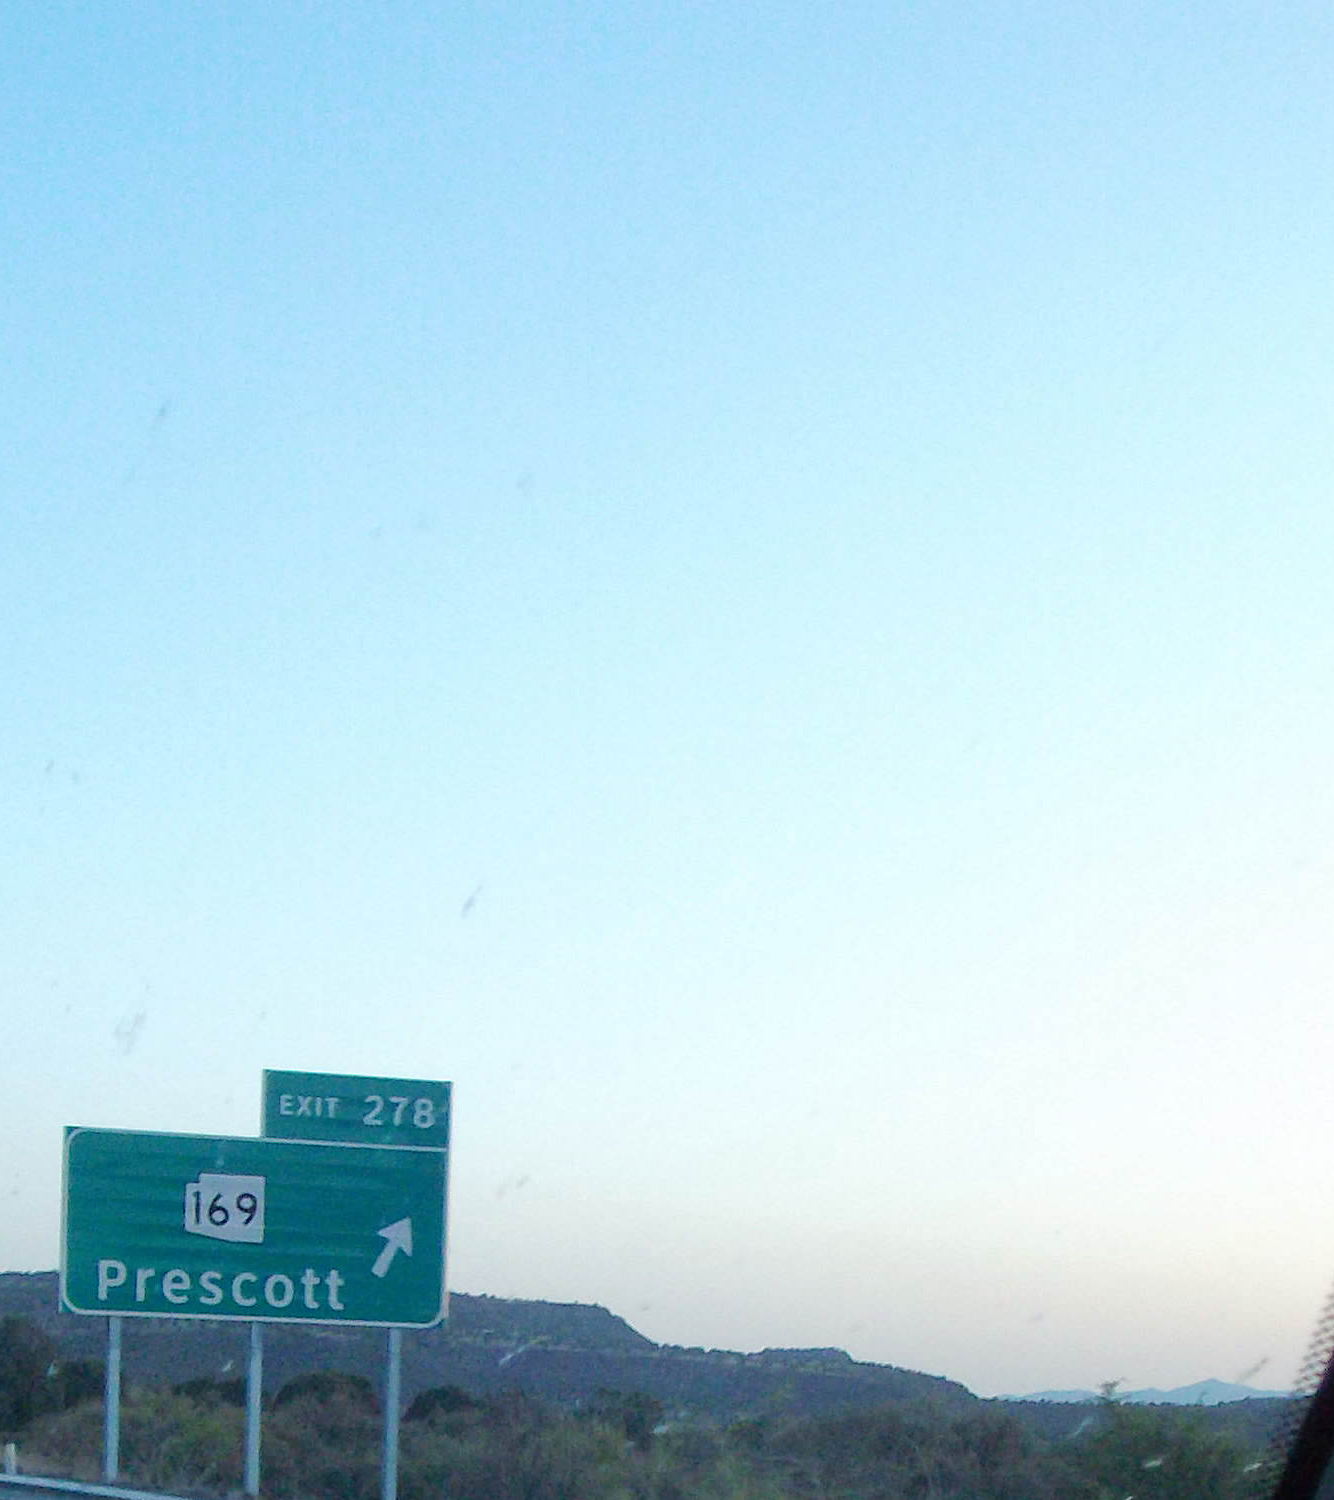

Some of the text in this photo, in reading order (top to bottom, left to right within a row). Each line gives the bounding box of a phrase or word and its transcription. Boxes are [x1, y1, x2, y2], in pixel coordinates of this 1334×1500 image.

[279, 1093, 437, 1130] EXIT 278
[191, 1191, 258, 1227] 169
[97, 1258, 346, 1311] Prescott
